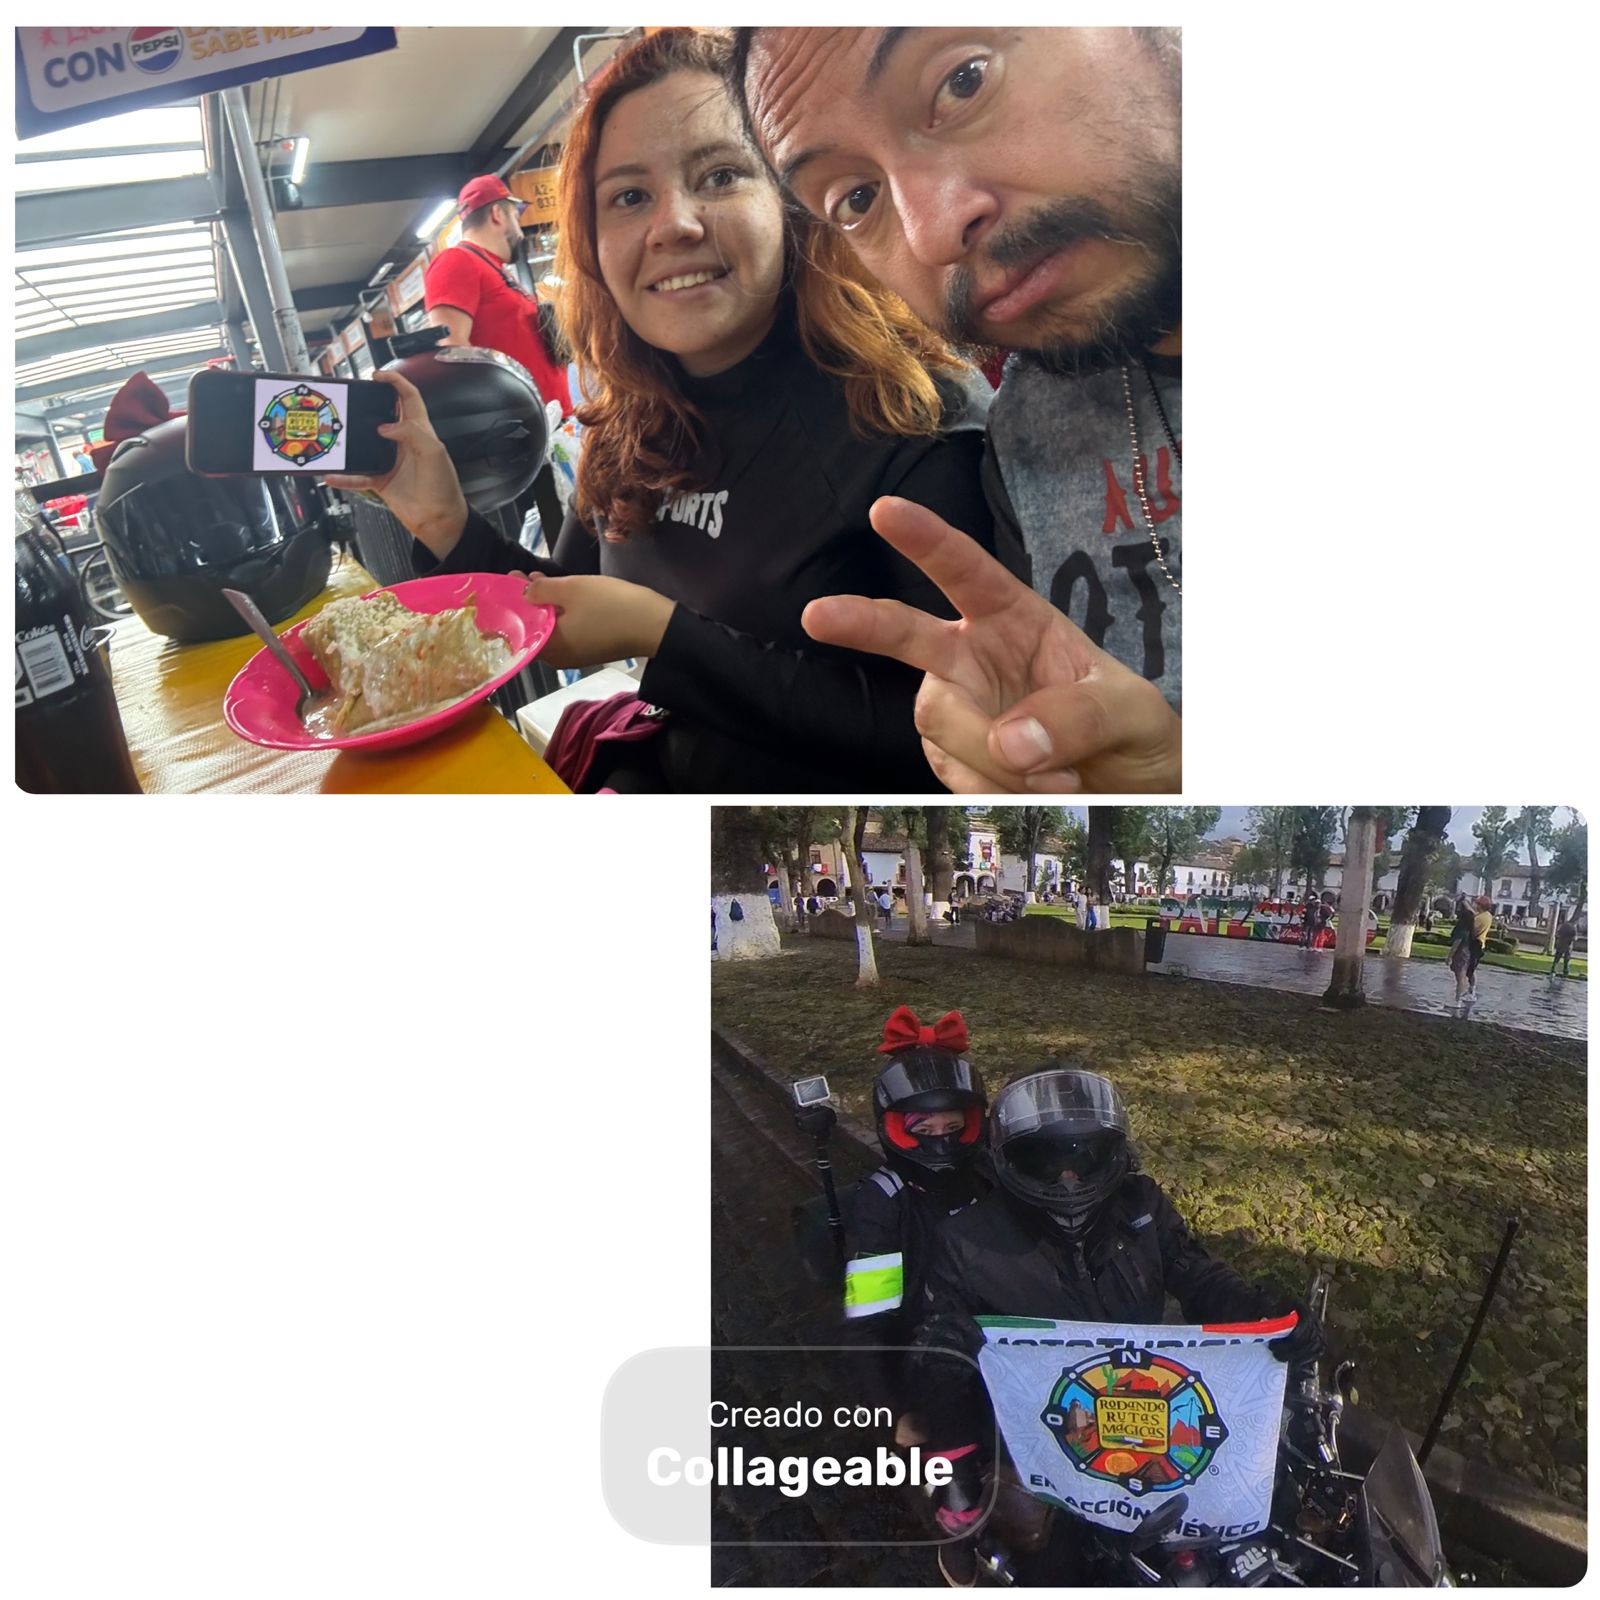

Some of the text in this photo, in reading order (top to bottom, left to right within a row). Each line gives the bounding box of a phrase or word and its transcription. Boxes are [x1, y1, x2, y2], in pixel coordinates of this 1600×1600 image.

[131, 35, 180, 57] PEPSI
[191, 26, 261, 60] SABE
[44, 42, 126, 88] CON
[655, 488, 729, 539] PORTS
[1121, 1350, 1141, 1363] N
[1206, 1425, 1221, 1439] E
[1128, 1479, 1143, 1491] S
